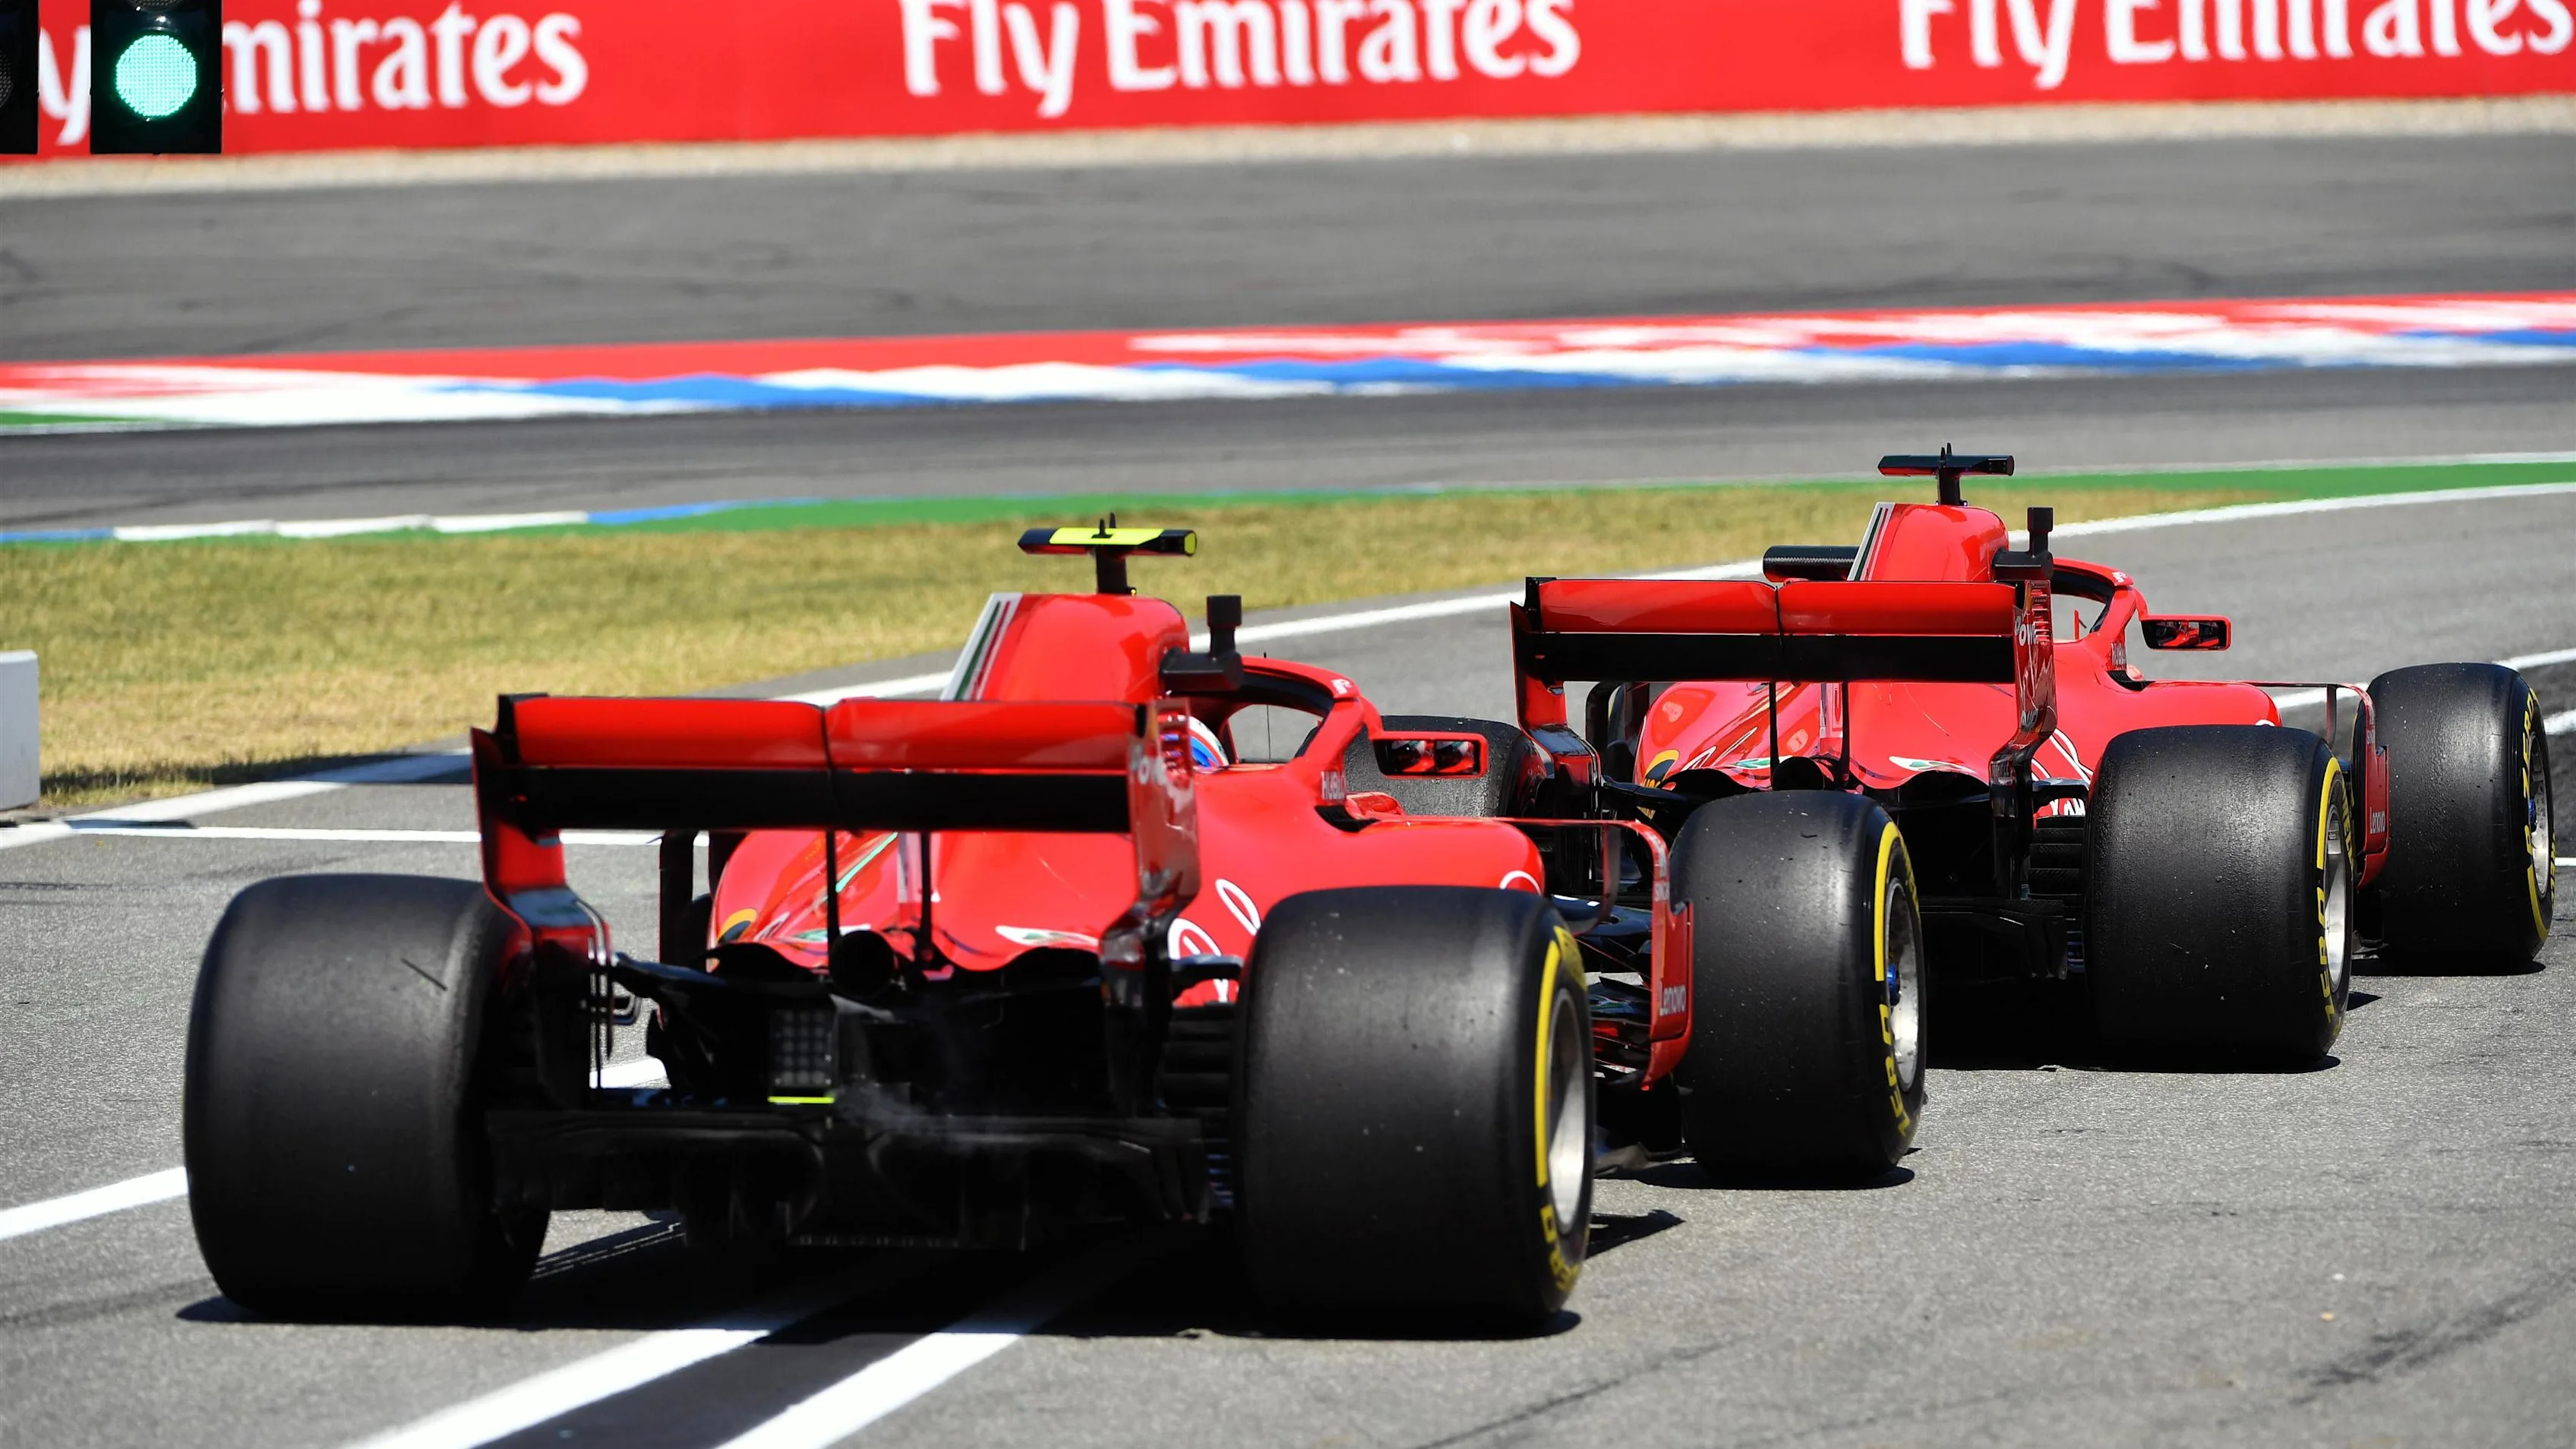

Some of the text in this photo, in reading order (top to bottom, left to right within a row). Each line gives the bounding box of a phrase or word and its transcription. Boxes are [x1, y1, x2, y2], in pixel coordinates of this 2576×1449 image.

[222, 0, 588, 113] mirates
[900, 0, 1580, 118] Fly Emirates
[1899, 0, 2574, 89] Fly Emirates
[2522, 693, 2534, 801] ZERO
[2369, 807, 2386, 835] Lenovo
[2316, 886, 2334, 1024] ZERO
[1879, 1003, 1911, 1138] ZERO
